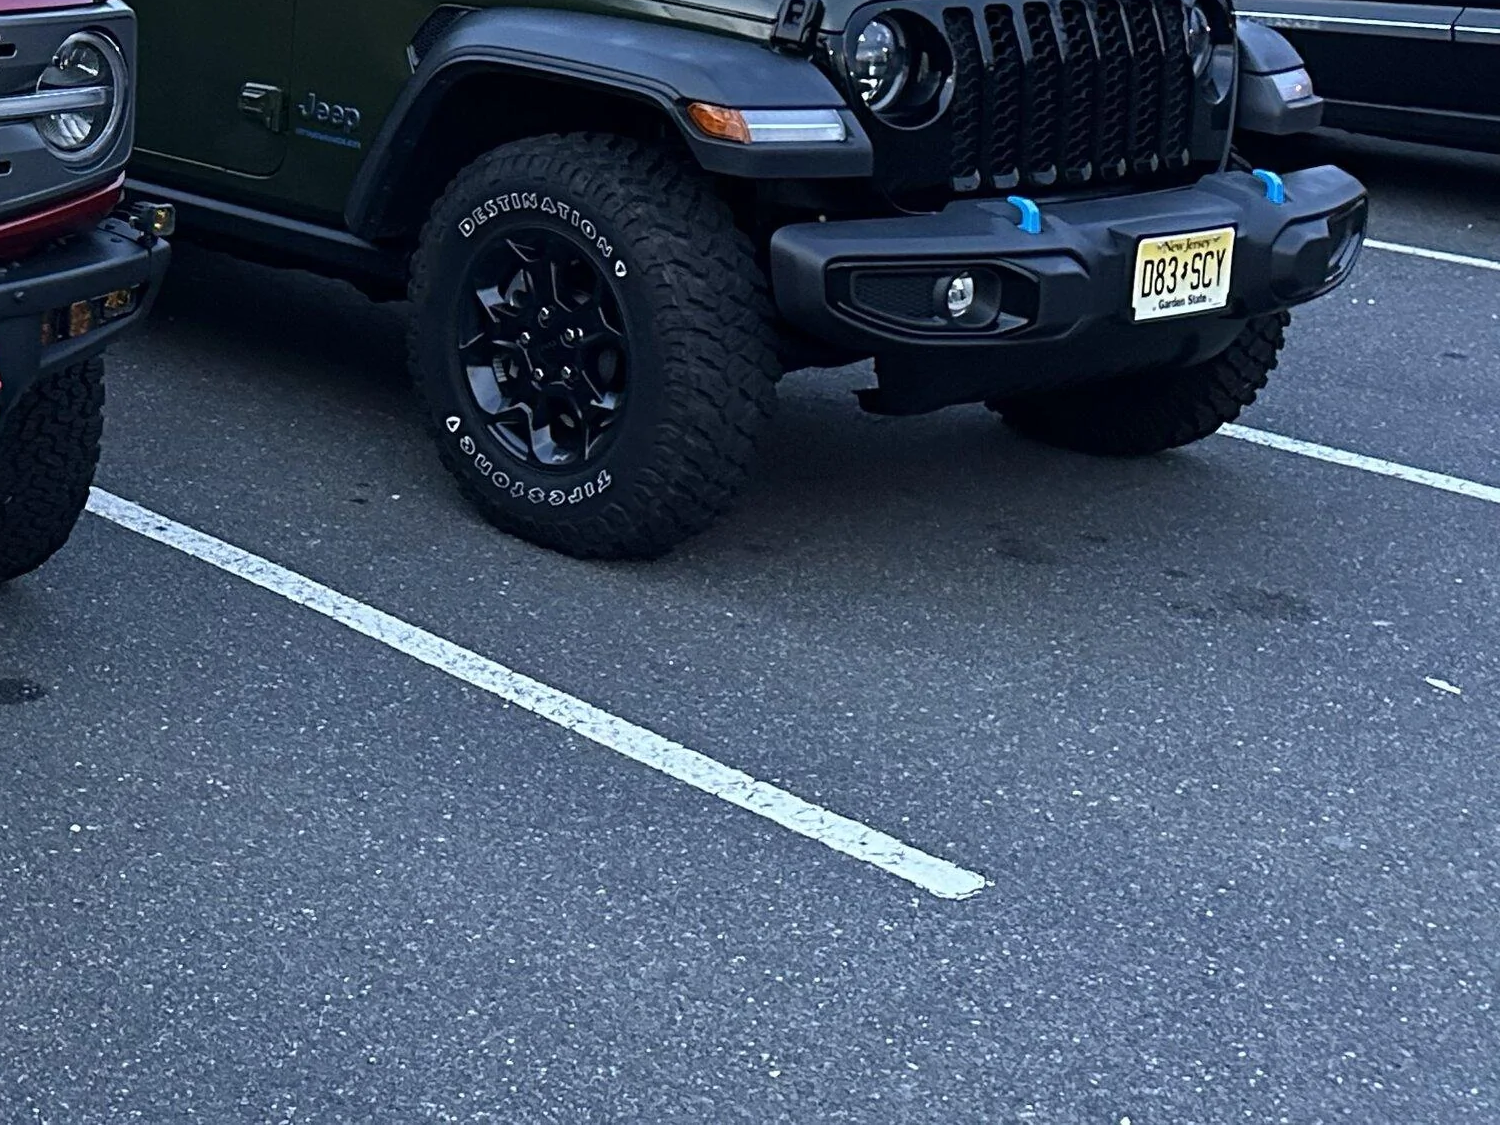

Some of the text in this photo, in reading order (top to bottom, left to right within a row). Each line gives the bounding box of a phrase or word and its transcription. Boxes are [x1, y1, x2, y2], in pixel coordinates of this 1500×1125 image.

[298, 92, 361, 134] Jeep
[458, 192, 613, 258] DESTINATION
[1162, 237, 1211, 252] New Jersey
[1158, 298, 1185, 310] Garden
[1187, 293, 1207, 305] State
